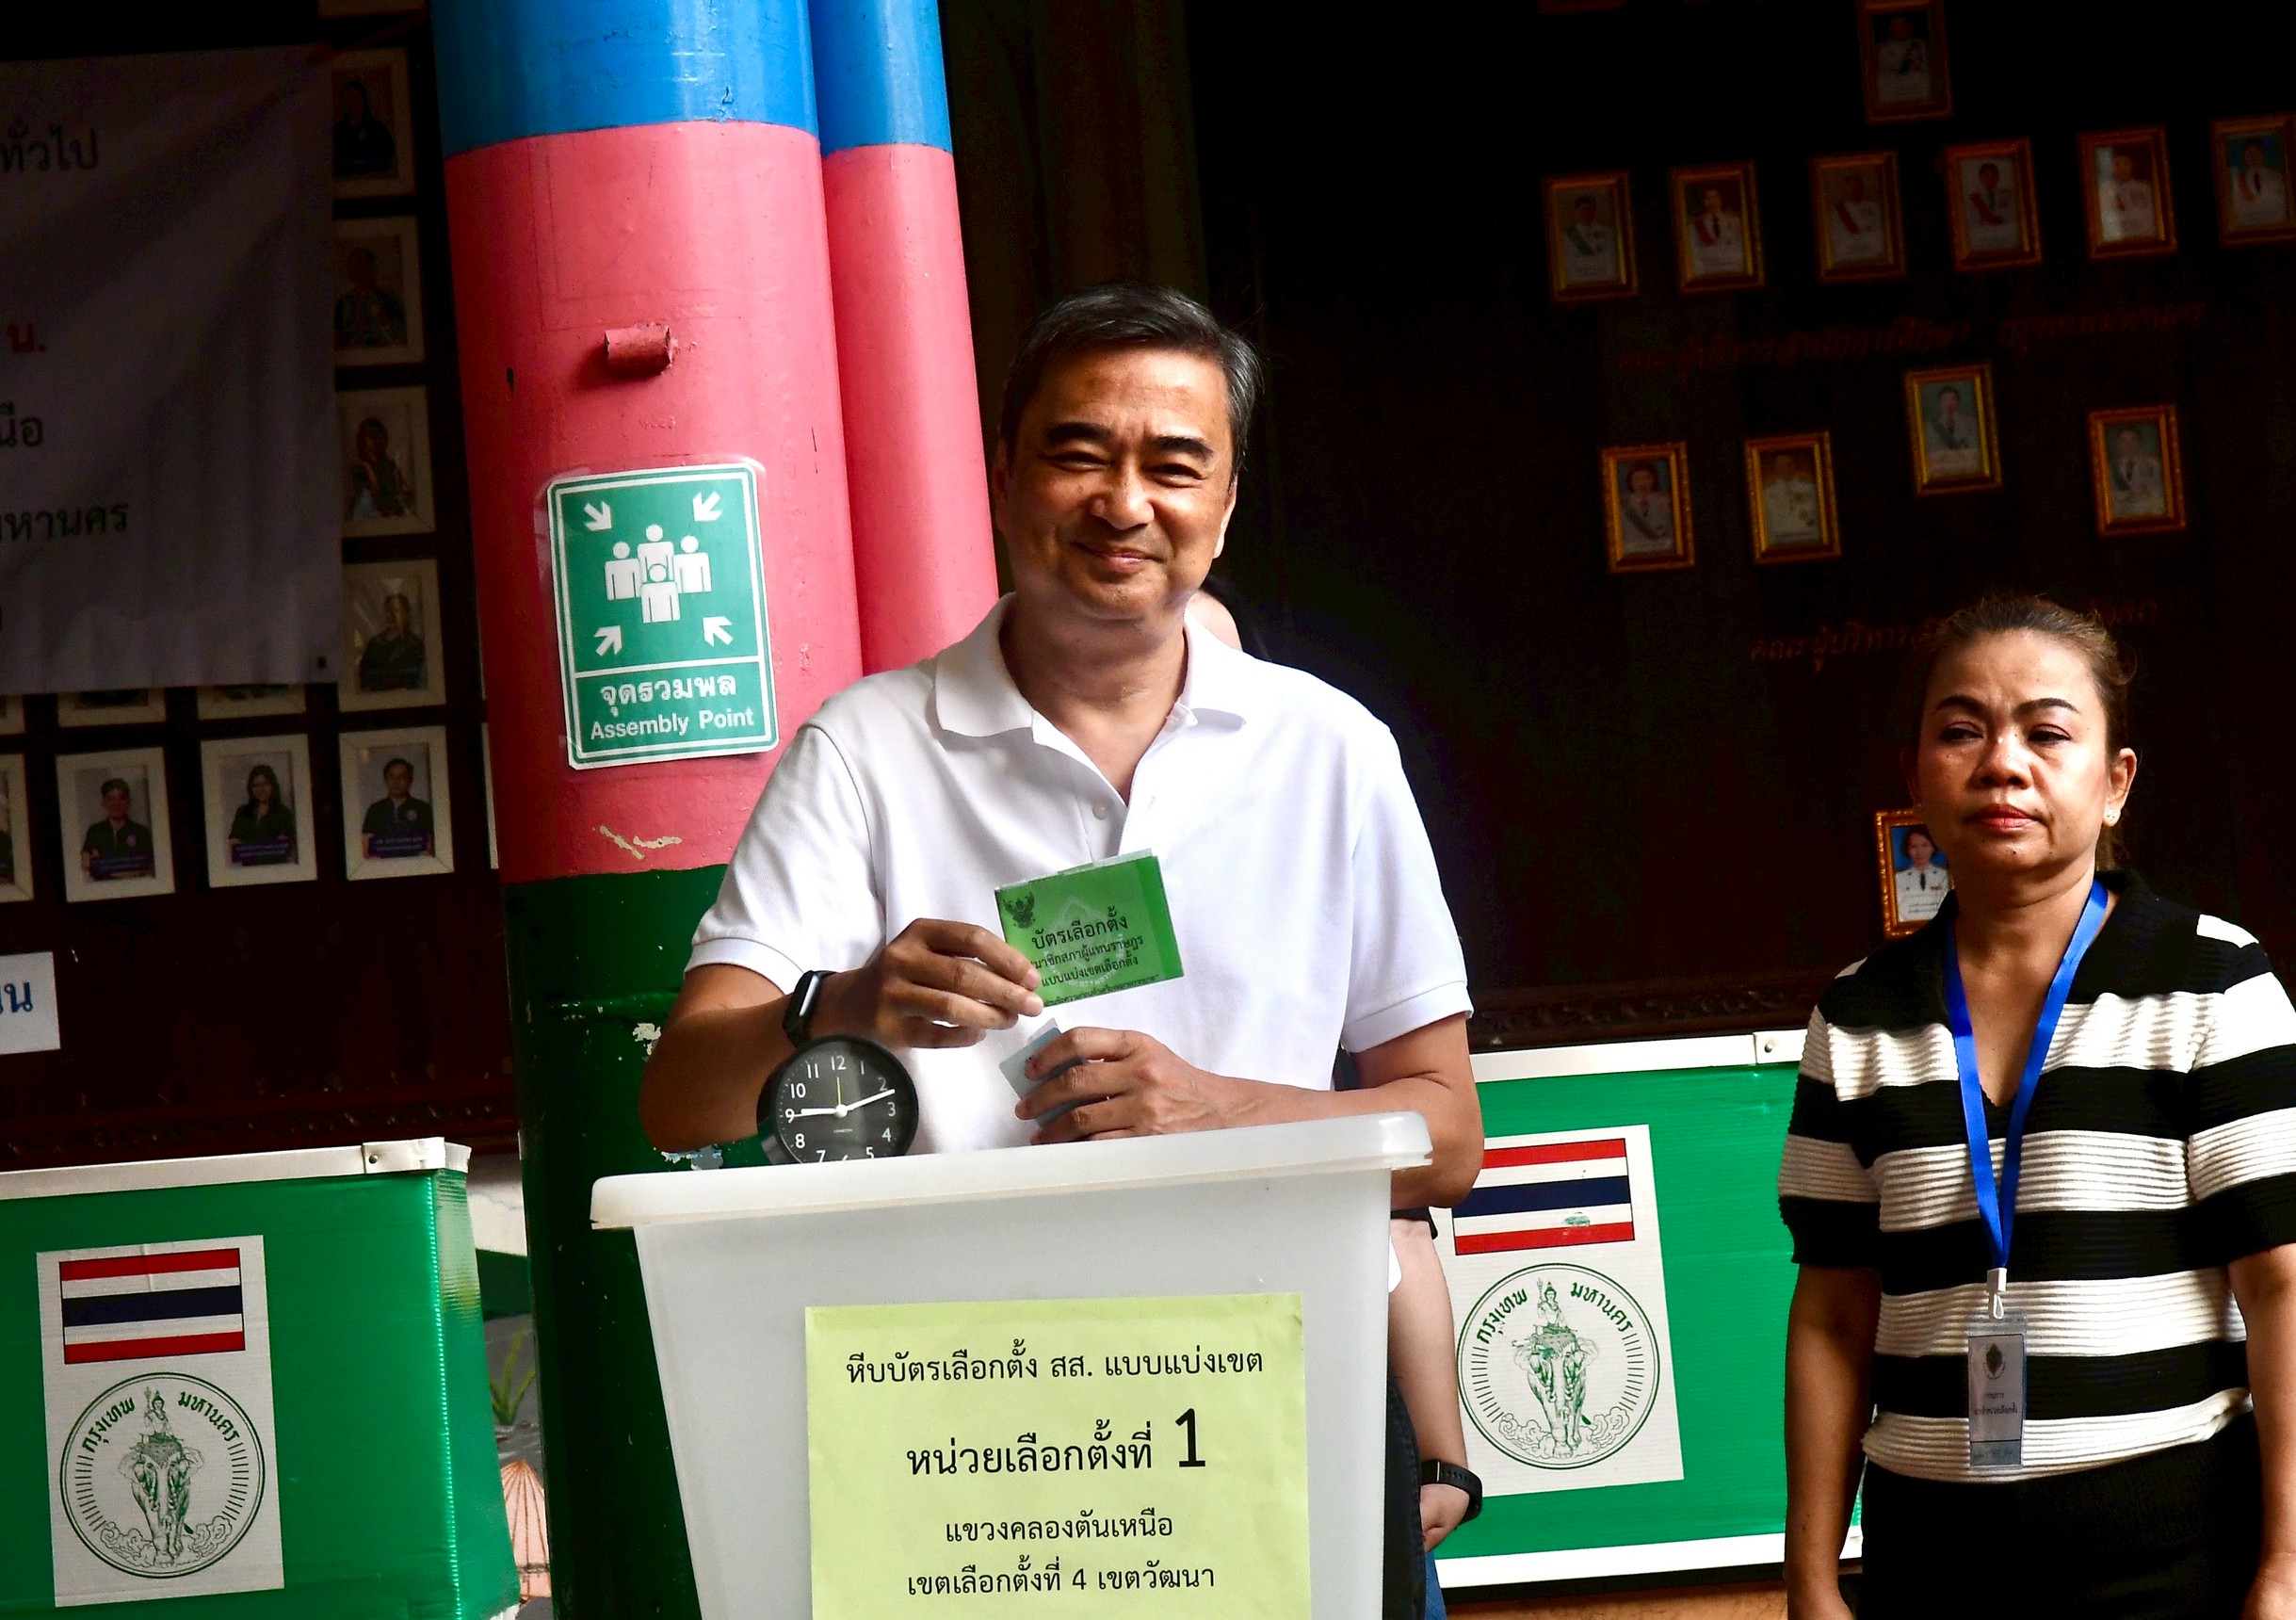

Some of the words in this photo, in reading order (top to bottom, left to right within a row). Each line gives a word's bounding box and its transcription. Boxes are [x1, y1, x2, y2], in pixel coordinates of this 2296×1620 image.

[0, 503, 129, 541] หานคร
[600, 674, 736, 718] จุดรวมพล
[590, 712, 689, 739] Assembly
[699, 707, 754, 730] Point
[1031, 905, 1128, 949] บัตรเลือกตั้ง
[807, 1062, 819, 1079] 11
[831, 1055, 847, 1071] 12
[790, 1082, 806, 1099] 10
[878, 1077, 888, 1092] 2
[784, 1108, 797, 1124] 9
[887, 1101, 897, 1117] 3
[795, 1132, 806, 1149] 8
[881, 1127, 892, 1142] 4
[1476, 1288, 1528, 1344] กรุงเทพ
[1570, 1281, 1634, 1333] มหานคร
[846, 1338, 1038, 1384] หีบบัตรเลือกตั้ง
[1050, 1355, 1092, 1378] สส.
[1105, 1344, 1263, 1376] แบบแบ่งเขต
[82, 1396, 136, 1454] กรุงเทพ
[177, 1391, 240, 1442] มหานคร
[906, 1418, 1153, 1475] หน่วยเลือกตั้งที่
[1174, 1407, 1206, 1467] 1
[946, 1507, 1173, 1543] แขวงคลองตันเหนือ
[908, 1554, 1060, 1596] เขตเลือกตั้งที่
[1072, 1568, 1087, 1591] 4
[1098, 1559, 1215, 1590] เขตวัฒนา
